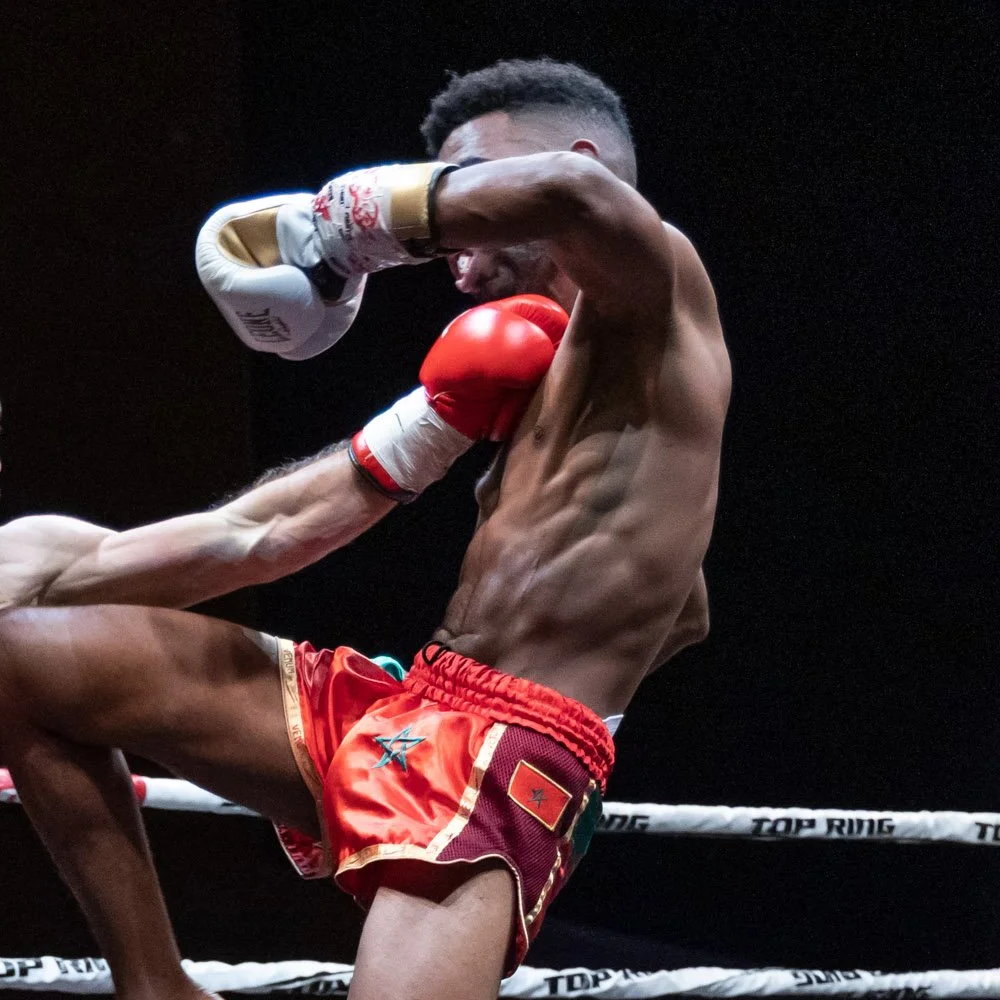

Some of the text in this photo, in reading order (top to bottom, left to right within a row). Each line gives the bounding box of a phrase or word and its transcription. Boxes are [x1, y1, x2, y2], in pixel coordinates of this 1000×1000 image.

[751, 817, 896, 836] TOP RING
[544, 968, 613, 996] TOP
